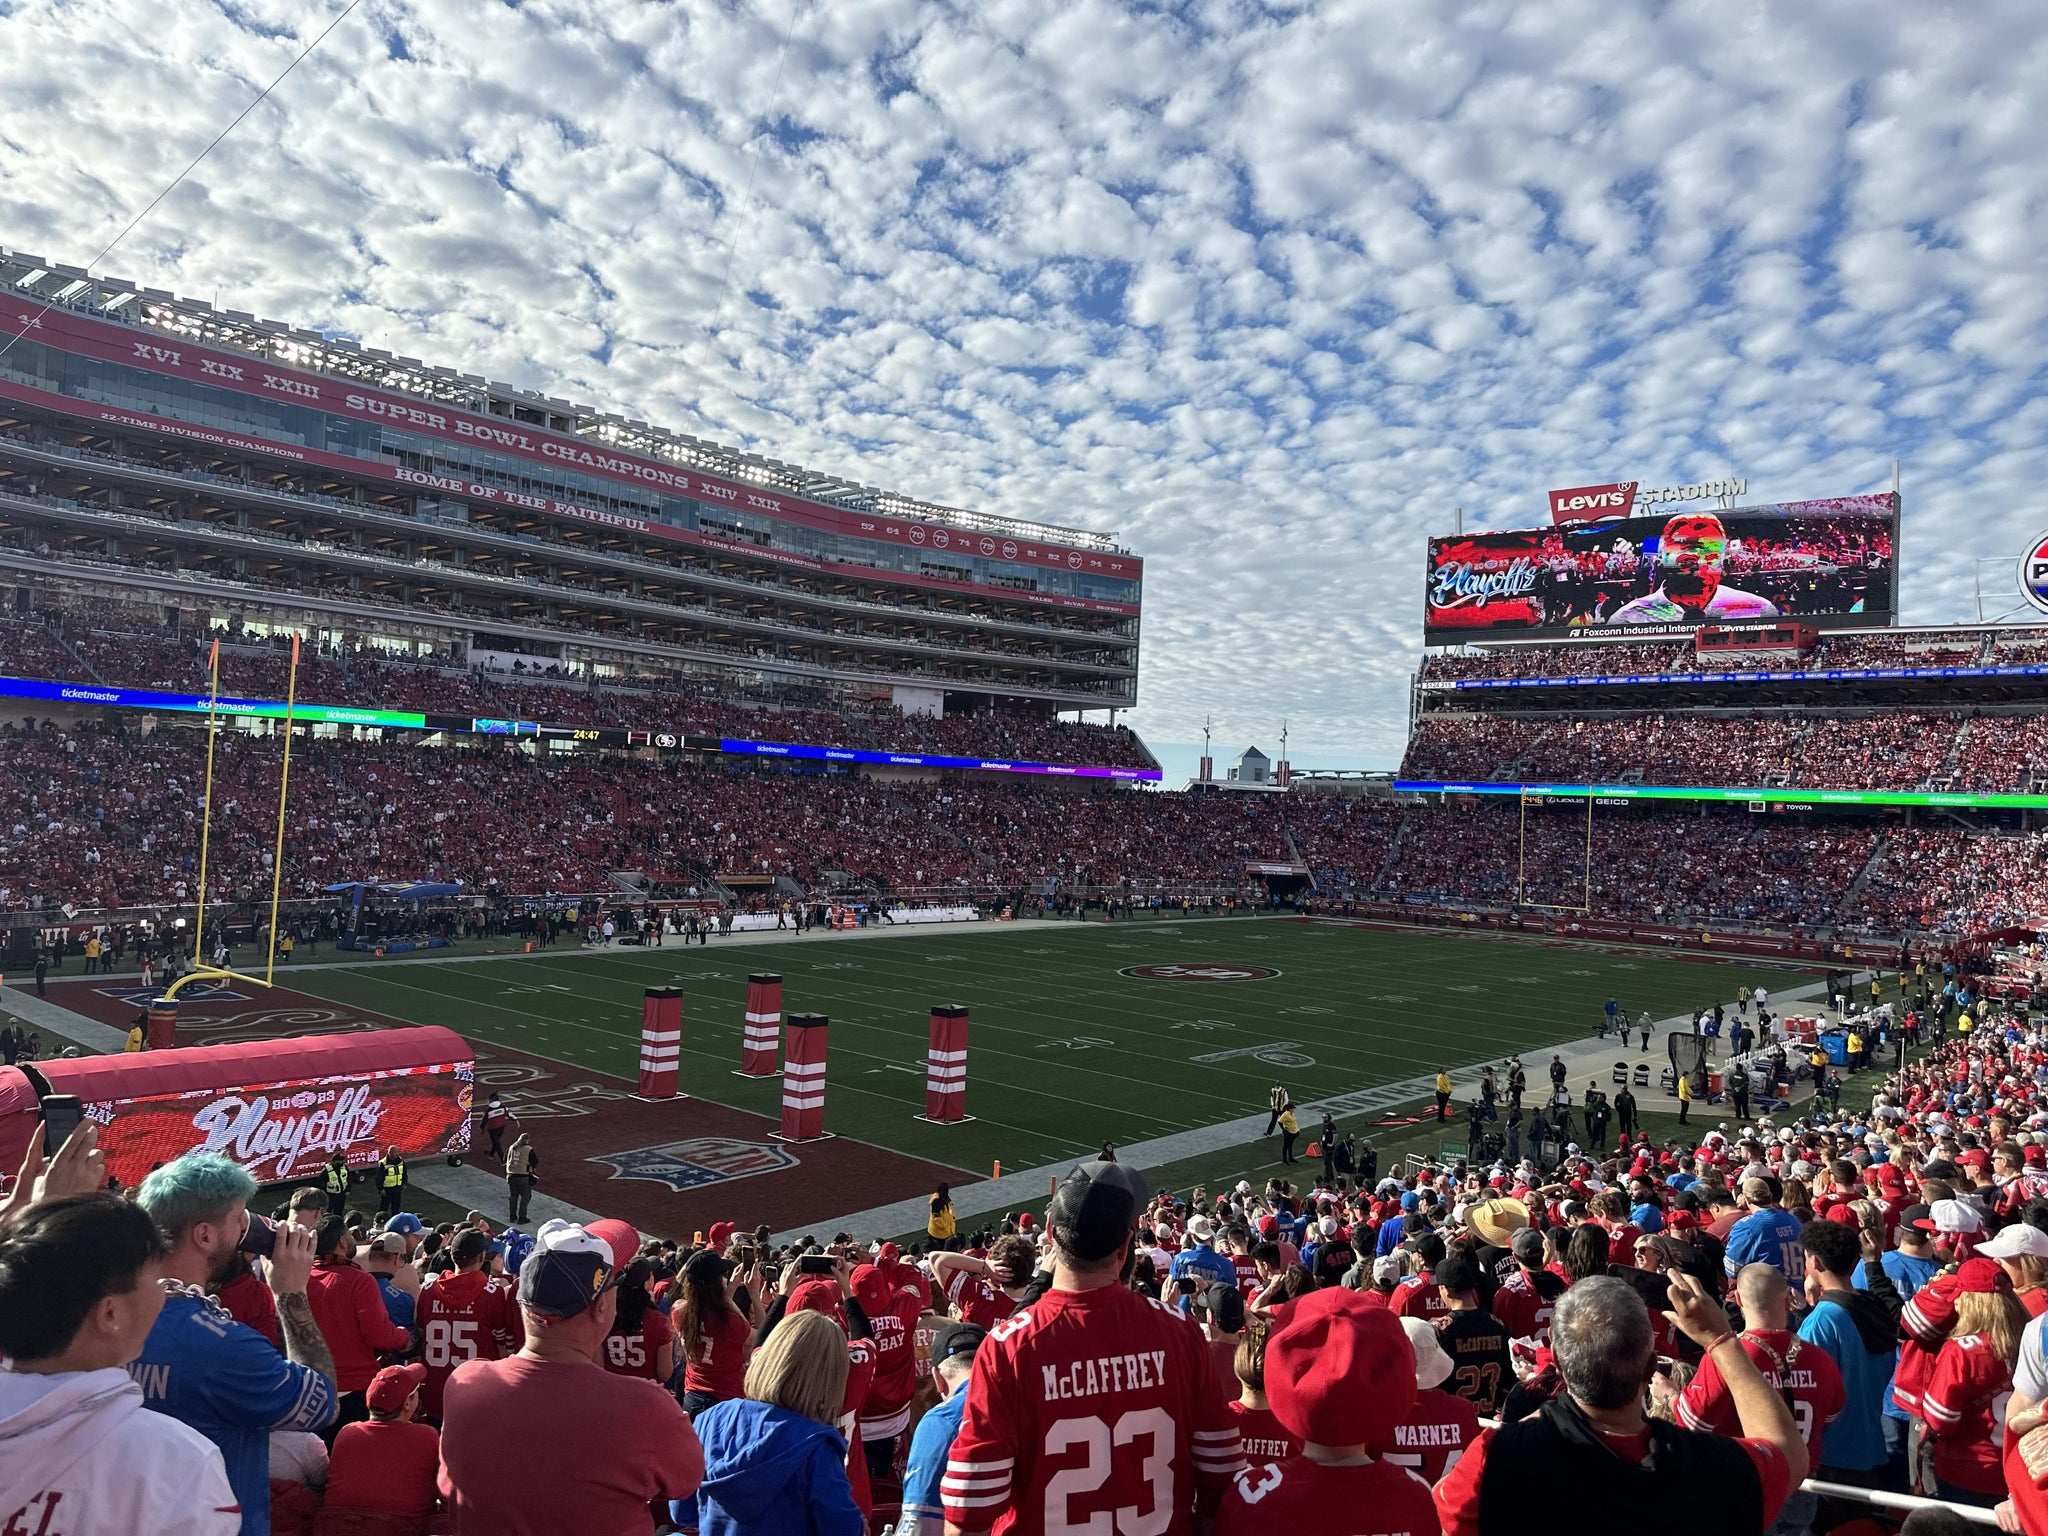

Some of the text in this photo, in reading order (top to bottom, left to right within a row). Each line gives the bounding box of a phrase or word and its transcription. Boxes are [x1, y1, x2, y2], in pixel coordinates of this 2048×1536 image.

[101, 412, 304, 460] 22-TIME DIVISION CHAMPIONS
[133, 342, 782, 512] XVI XIX XXIII SUPER BOWL CHAMPIONS XXIV XXIX
[394, 467, 651, 533] HOME OF THE FAITHFUL
[1641, 477, 1748, 504] STADIUM
[730, 544, 778, 560] CONFERENCE
[779, 555, 822, 569] CHAMPIONS
[1429, 556, 1538, 609] Playoffs
[1583, 628, 1622, 637] Foxconn
[1623, 625, 1668, 635] Industrial
[61, 687, 120, 702] ticketmaster
[325, 710, 378, 722] ticketmaster
[573, 729, 600, 741] 24:47
[757, 745, 789, 754] ticketmaster
[826, 751, 855, 760] ticketmaster
[890, 756, 923, 764] ticketmaster
[981, 761, 1012, 770] ticketmaster
[1047, 766, 1076, 774] ticketmaster
[1595, 798, 1629, 806] GEICO
[187, 1084, 388, 1177] Playoffs
[1775, 1225, 1794, 1238] GOFF
[1236, 1266, 1257, 1275] PURDY
[425, 1319, 479, 1368] 85
[607, 1335, 646, 1368] 85
[879, 1332, 906, 1353] BAY
[1455, 1335, 1503, 1353] McCAFFREY
[1042, 1350, 1167, 1401] McCAFFREY
[1394, 1423, 1462, 1446] WARNER
[1044, 1406, 1176, 1536] 23
